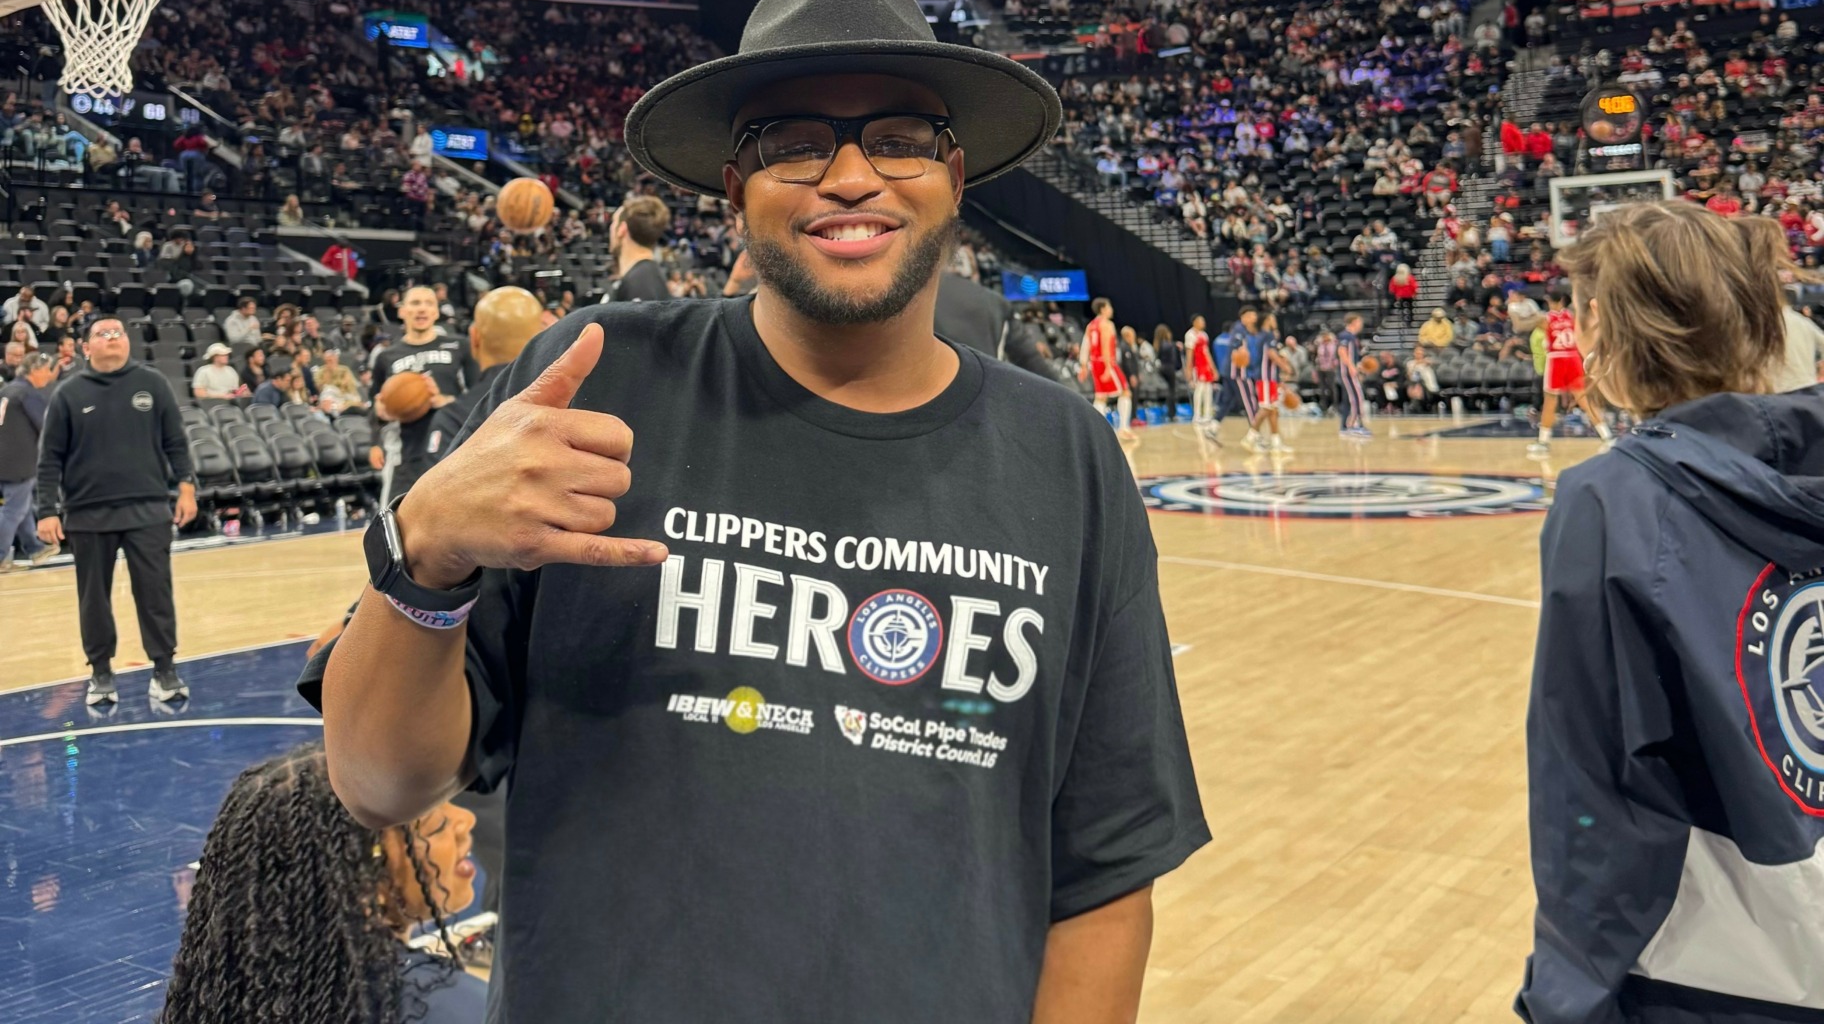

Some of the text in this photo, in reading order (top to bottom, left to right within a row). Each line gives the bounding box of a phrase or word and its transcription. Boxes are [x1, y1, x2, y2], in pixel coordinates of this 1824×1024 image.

[663, 506, 1049, 596] CLIPPERS COMMUNITY
[856, 593, 938, 629] LOS ANGELES
[1747, 589, 1779, 656] LOS
[860, 654, 925, 680] CLIPPERS
[667, 694, 815, 728] IBEW & NECA
[683, 713, 709, 723] LOCAL
[869, 712, 921, 737] SoCal
[924, 720, 967, 744] Pipe
[871, 733, 934, 758] District
[981, 752, 998, 769] 16
